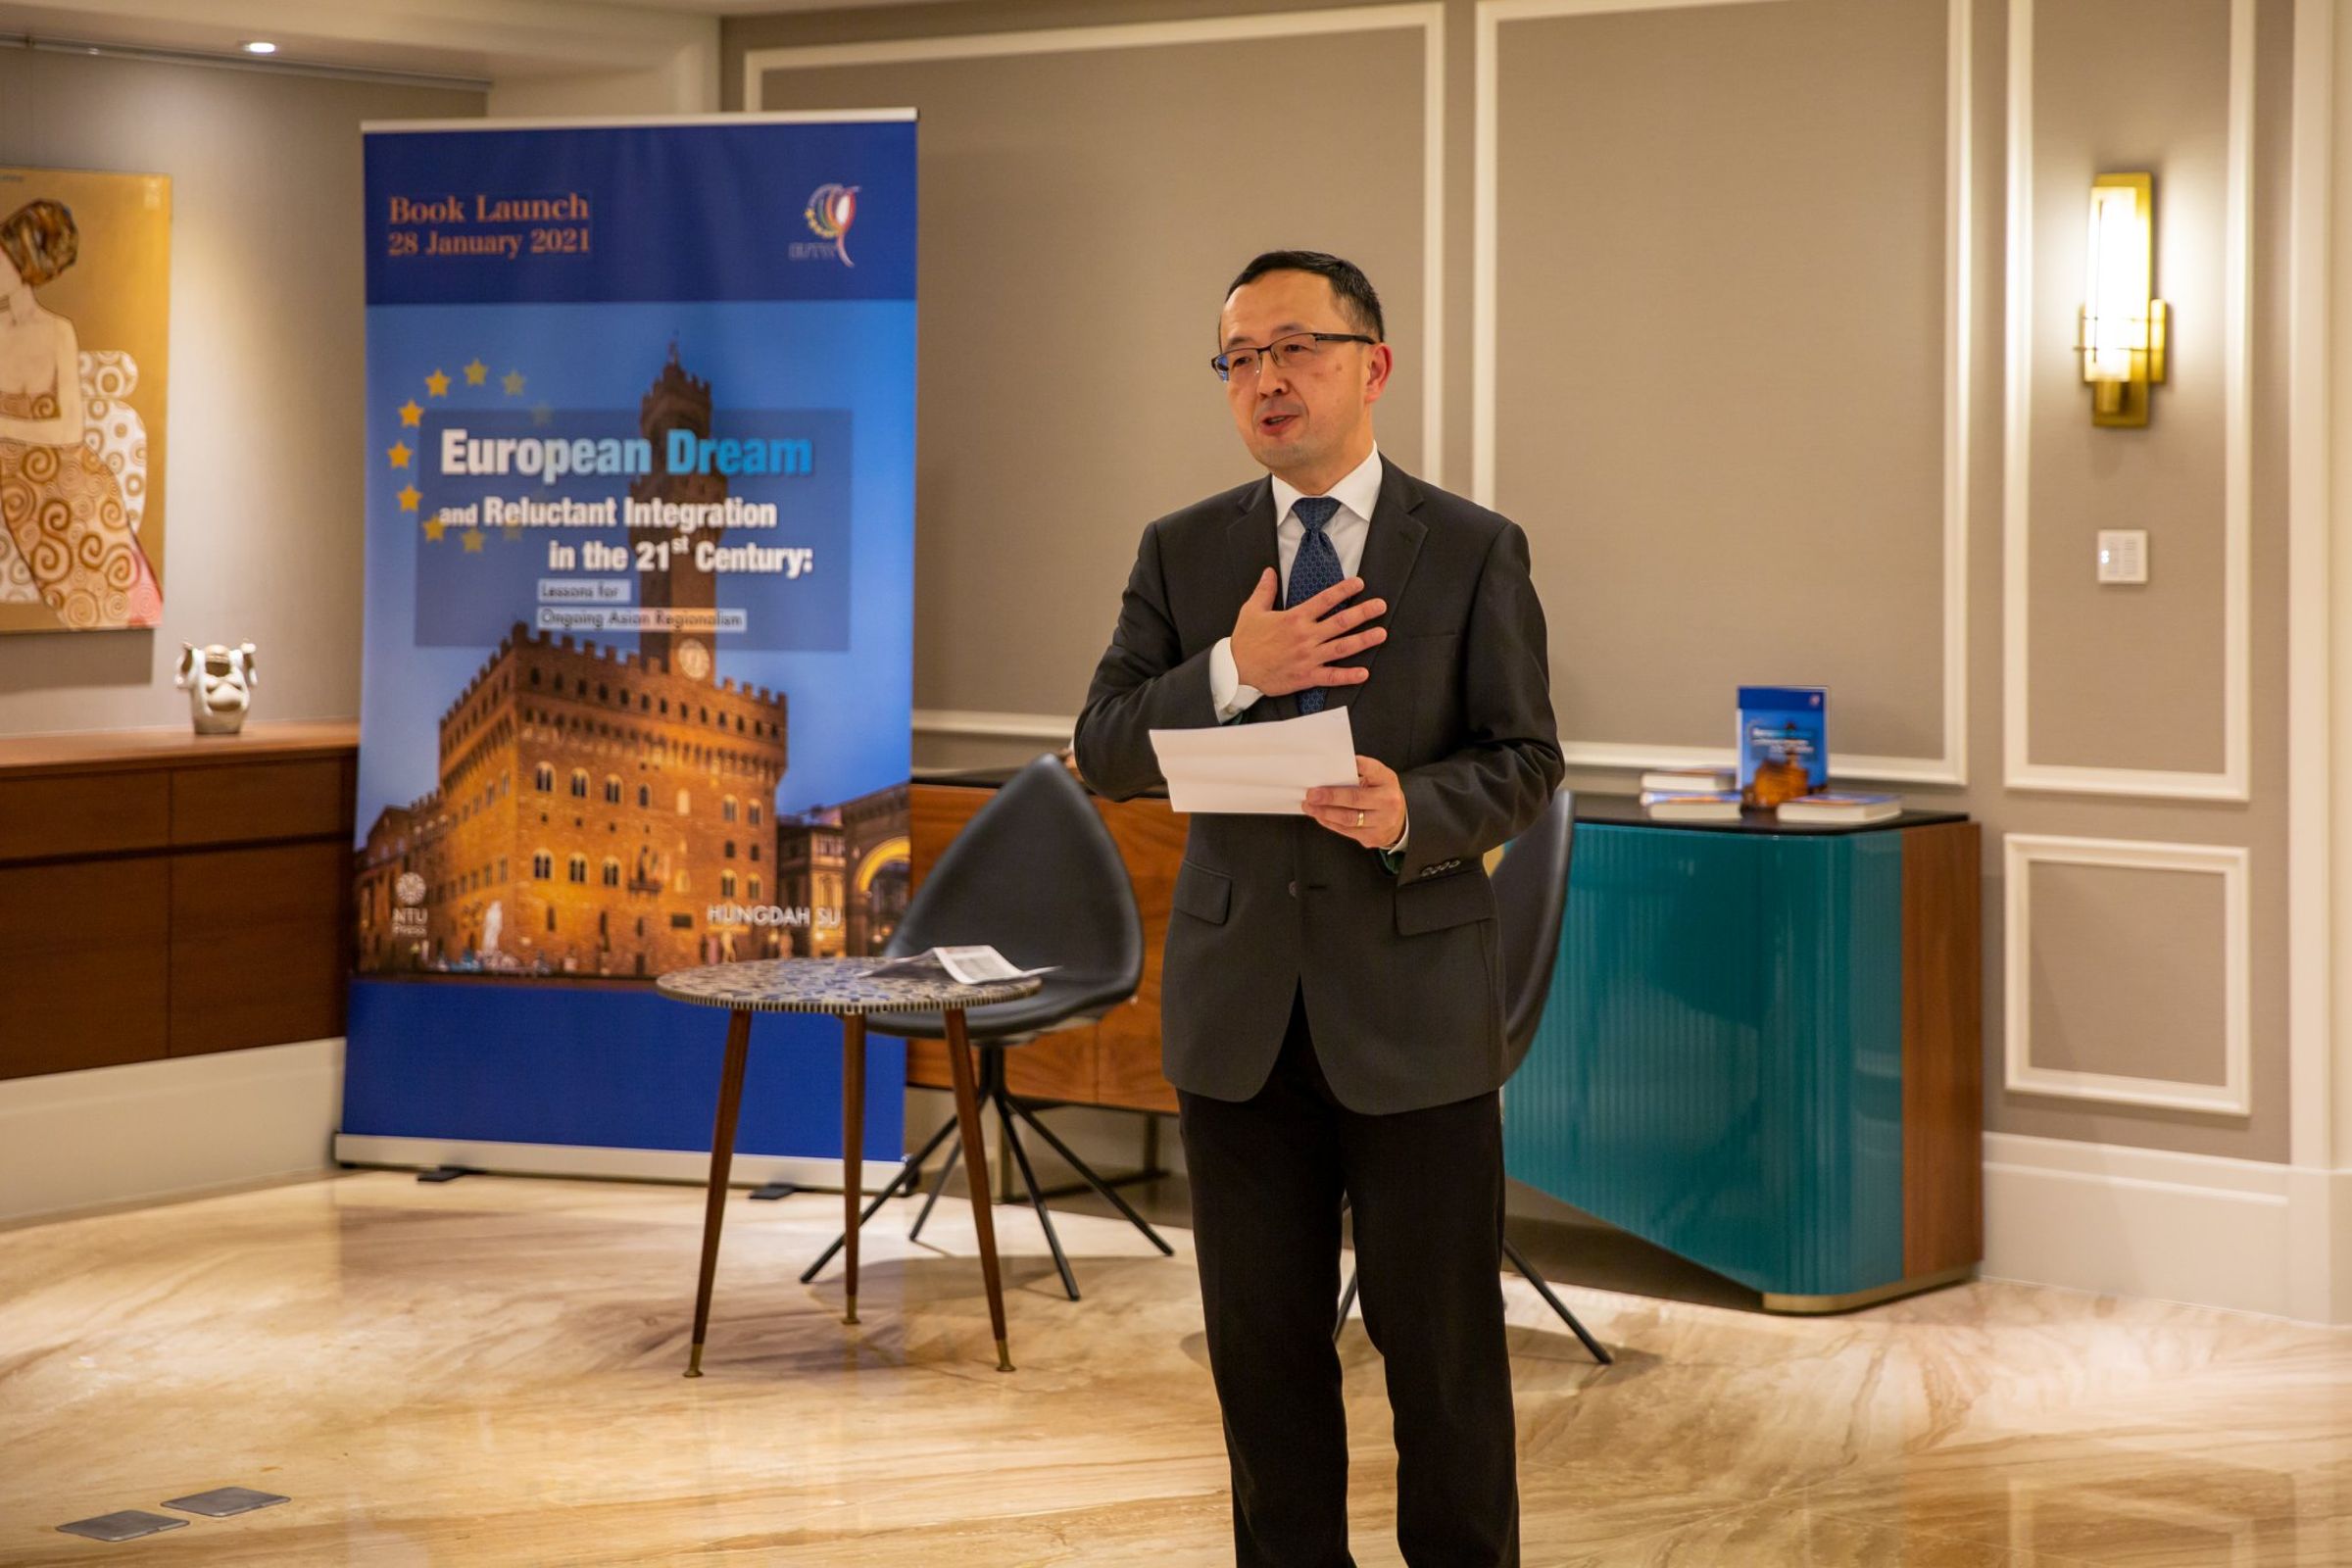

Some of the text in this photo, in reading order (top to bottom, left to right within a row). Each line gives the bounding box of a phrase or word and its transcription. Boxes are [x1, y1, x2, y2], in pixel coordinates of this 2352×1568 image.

[390, 192, 589, 224] Book Launch
[389, 227, 589, 260] 28 January 2021
[441, 428, 813, 485] European Dream
[439, 496, 777, 533] and Reluctant Integration
[549, 540, 575, 570] in
[583, 540, 628, 571] the
[695, 542, 813, 579] Century:
[542, 580, 619, 598] Lessons for
[541, 608, 743, 630] Ongoing Asian Regionalism
[392, 907, 428, 925] NTU
[707, 905, 841, 927] HUNGDAH SU
